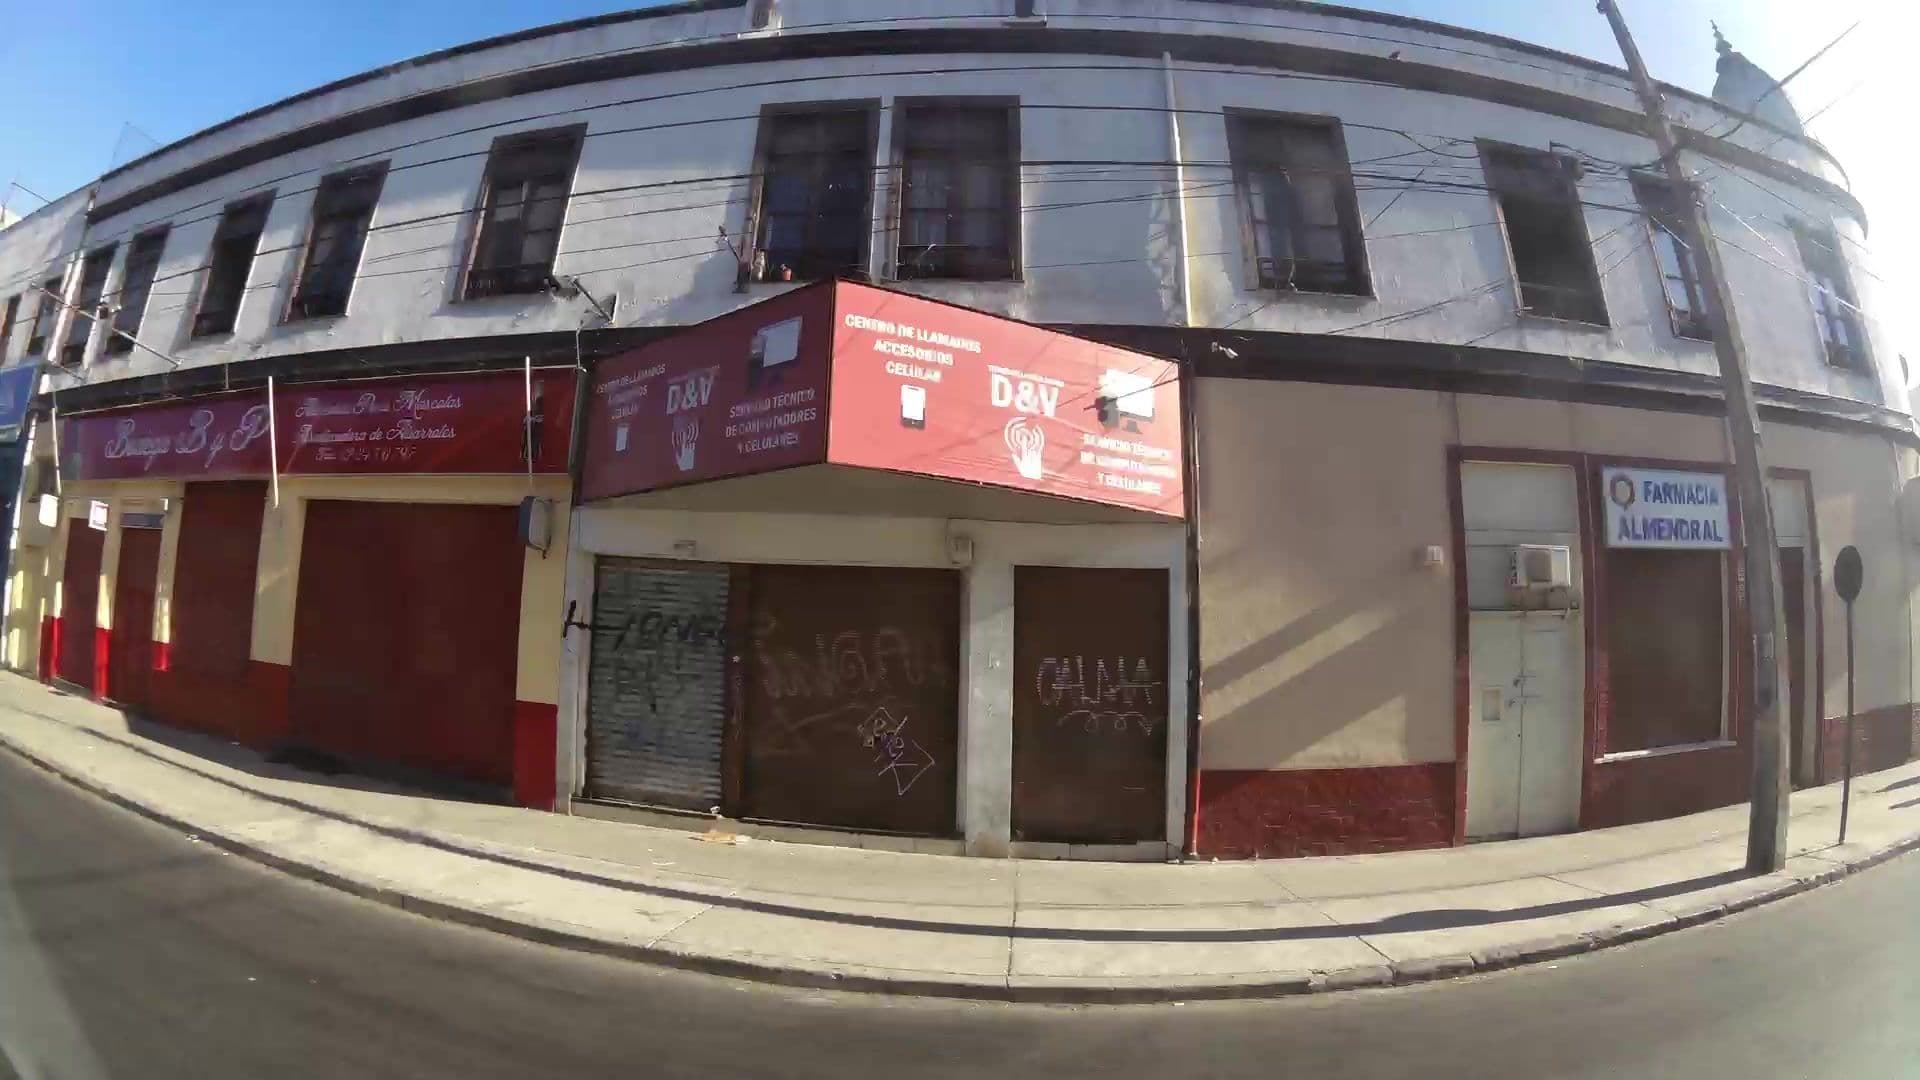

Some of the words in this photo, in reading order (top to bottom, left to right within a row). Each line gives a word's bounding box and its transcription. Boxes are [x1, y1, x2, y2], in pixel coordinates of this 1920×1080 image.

[897, 322, 915, 339] DE
[666, 373, 715, 415] D&V
[991, 372, 1059, 417] D&V
[725, 424, 737, 438] DE
[1643, 480, 1719, 505] FARMACIA
[1618, 514, 1723, 542] ALMENDRAL
